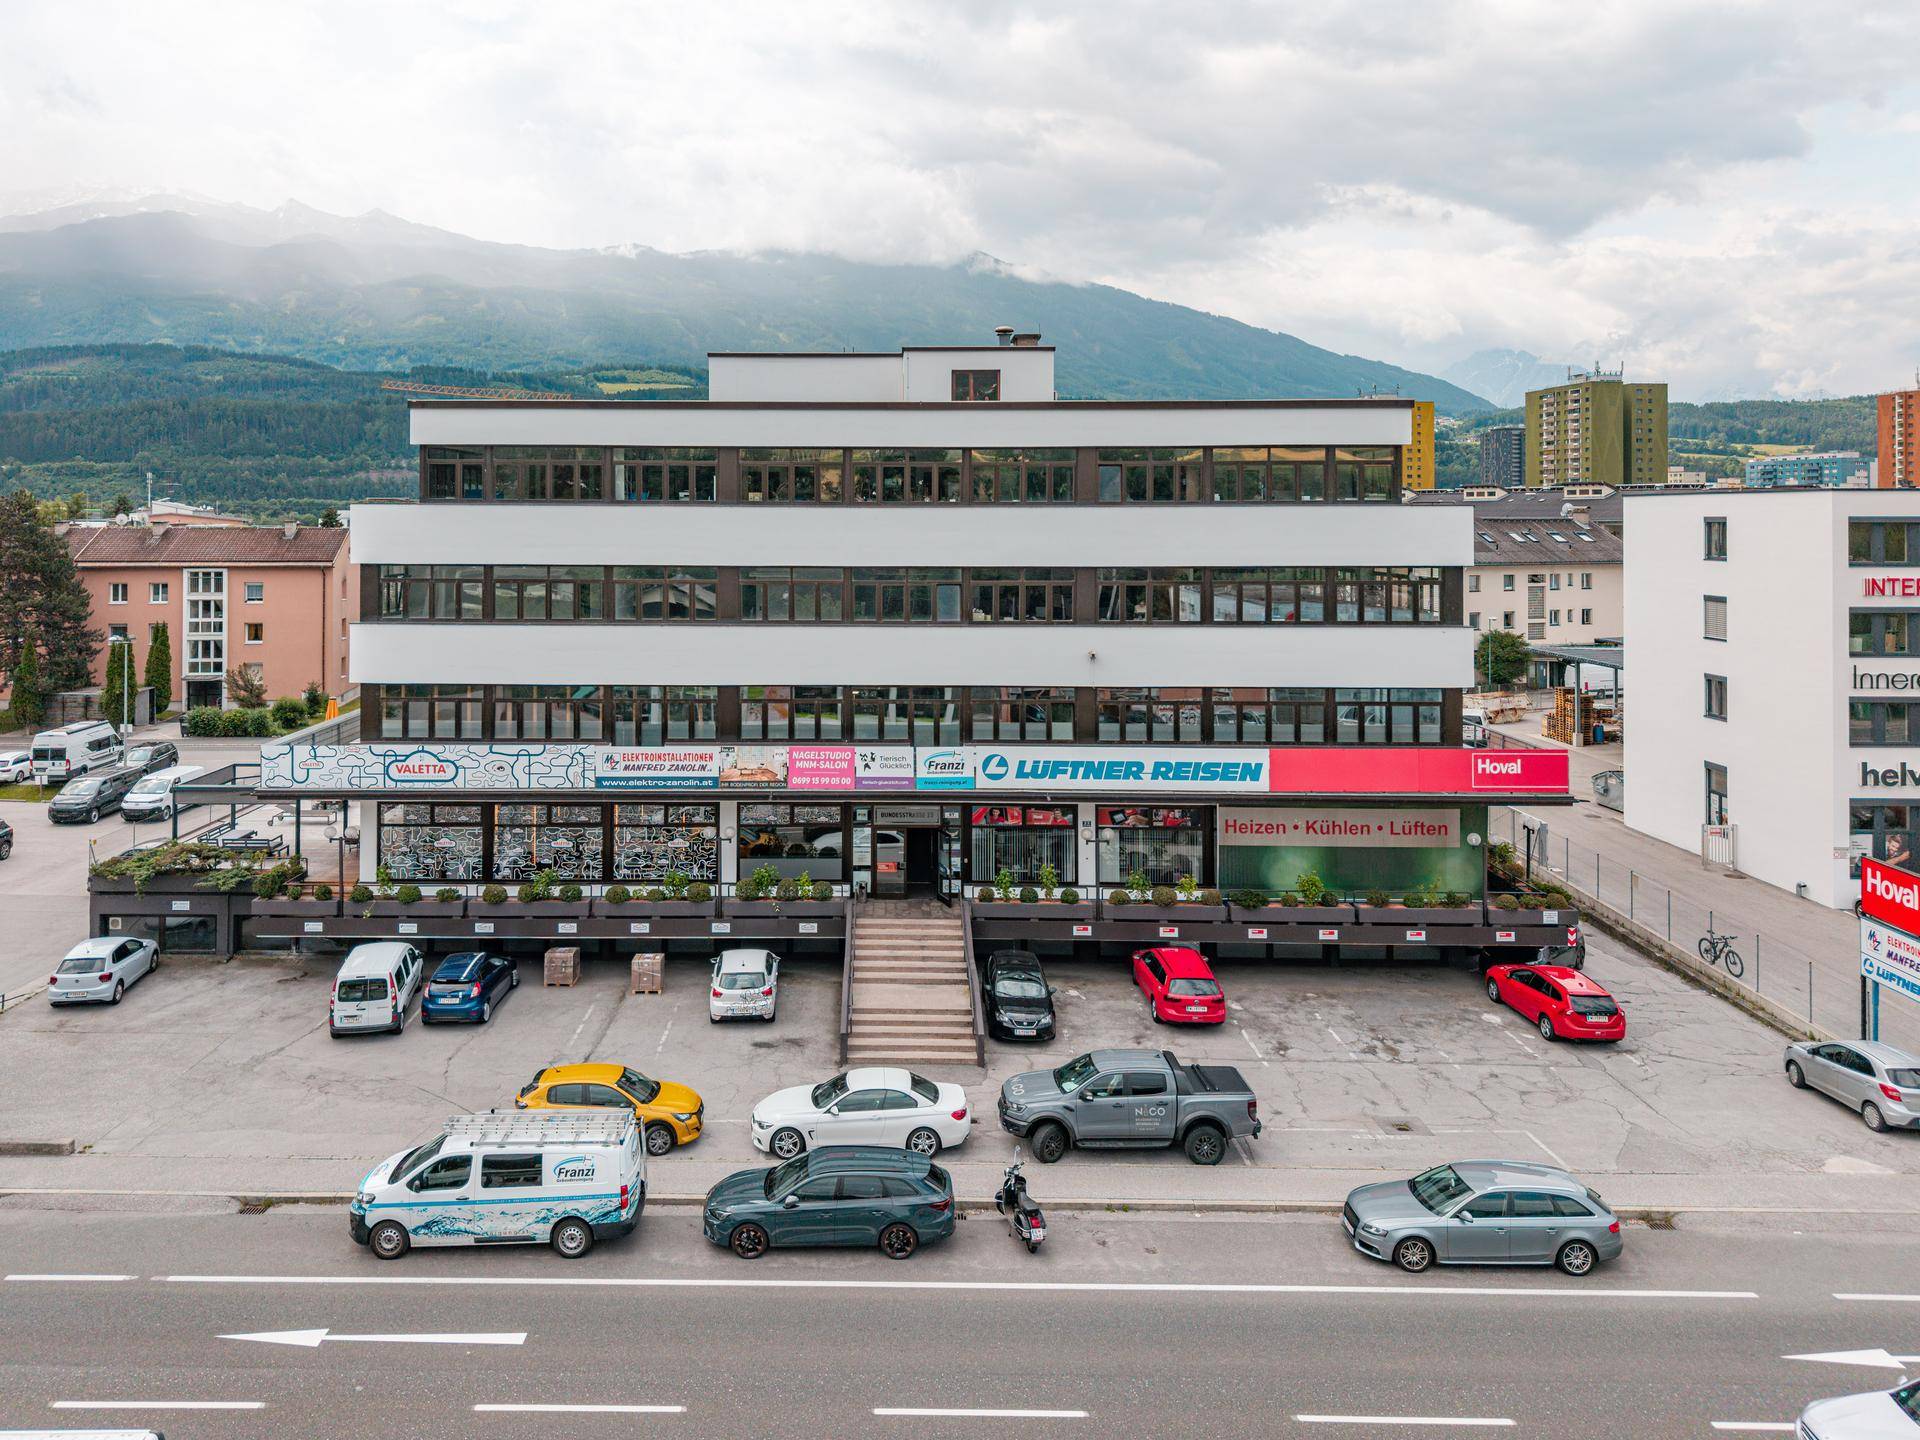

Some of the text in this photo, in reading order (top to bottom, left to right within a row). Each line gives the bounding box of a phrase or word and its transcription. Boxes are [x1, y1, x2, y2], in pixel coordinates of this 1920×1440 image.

[1864, 577, 1920, 597] INTE
[1853, 664, 1920, 690] Inner
[622, 752, 714, 762] ELEKTROINSTALLATIONEN
[792, 751, 852, 760] NAGELSTUDIO
[395, 764, 448, 775] VALETTA
[622, 763, 666, 772] MANFRED
[667, 763, 707, 772] ZANOLIN
[795, 760, 848, 769] MNM-SALON
[927, 761, 965, 770] Franzi
[1477, 758, 1522, 775] Hoval
[1014, 760, 1264, 782] LÜFTNER REISEN
[602, 779, 713, 787] www.elektro-zanolin.at
[792, 776, 851, 785] 0699 15 99 05 00
[1224, 818, 1449, 836] Heizen Kühlen Lüften
[1866, 867, 1919, 911] Hoval
[557, 1167, 596, 1178] Franzi
